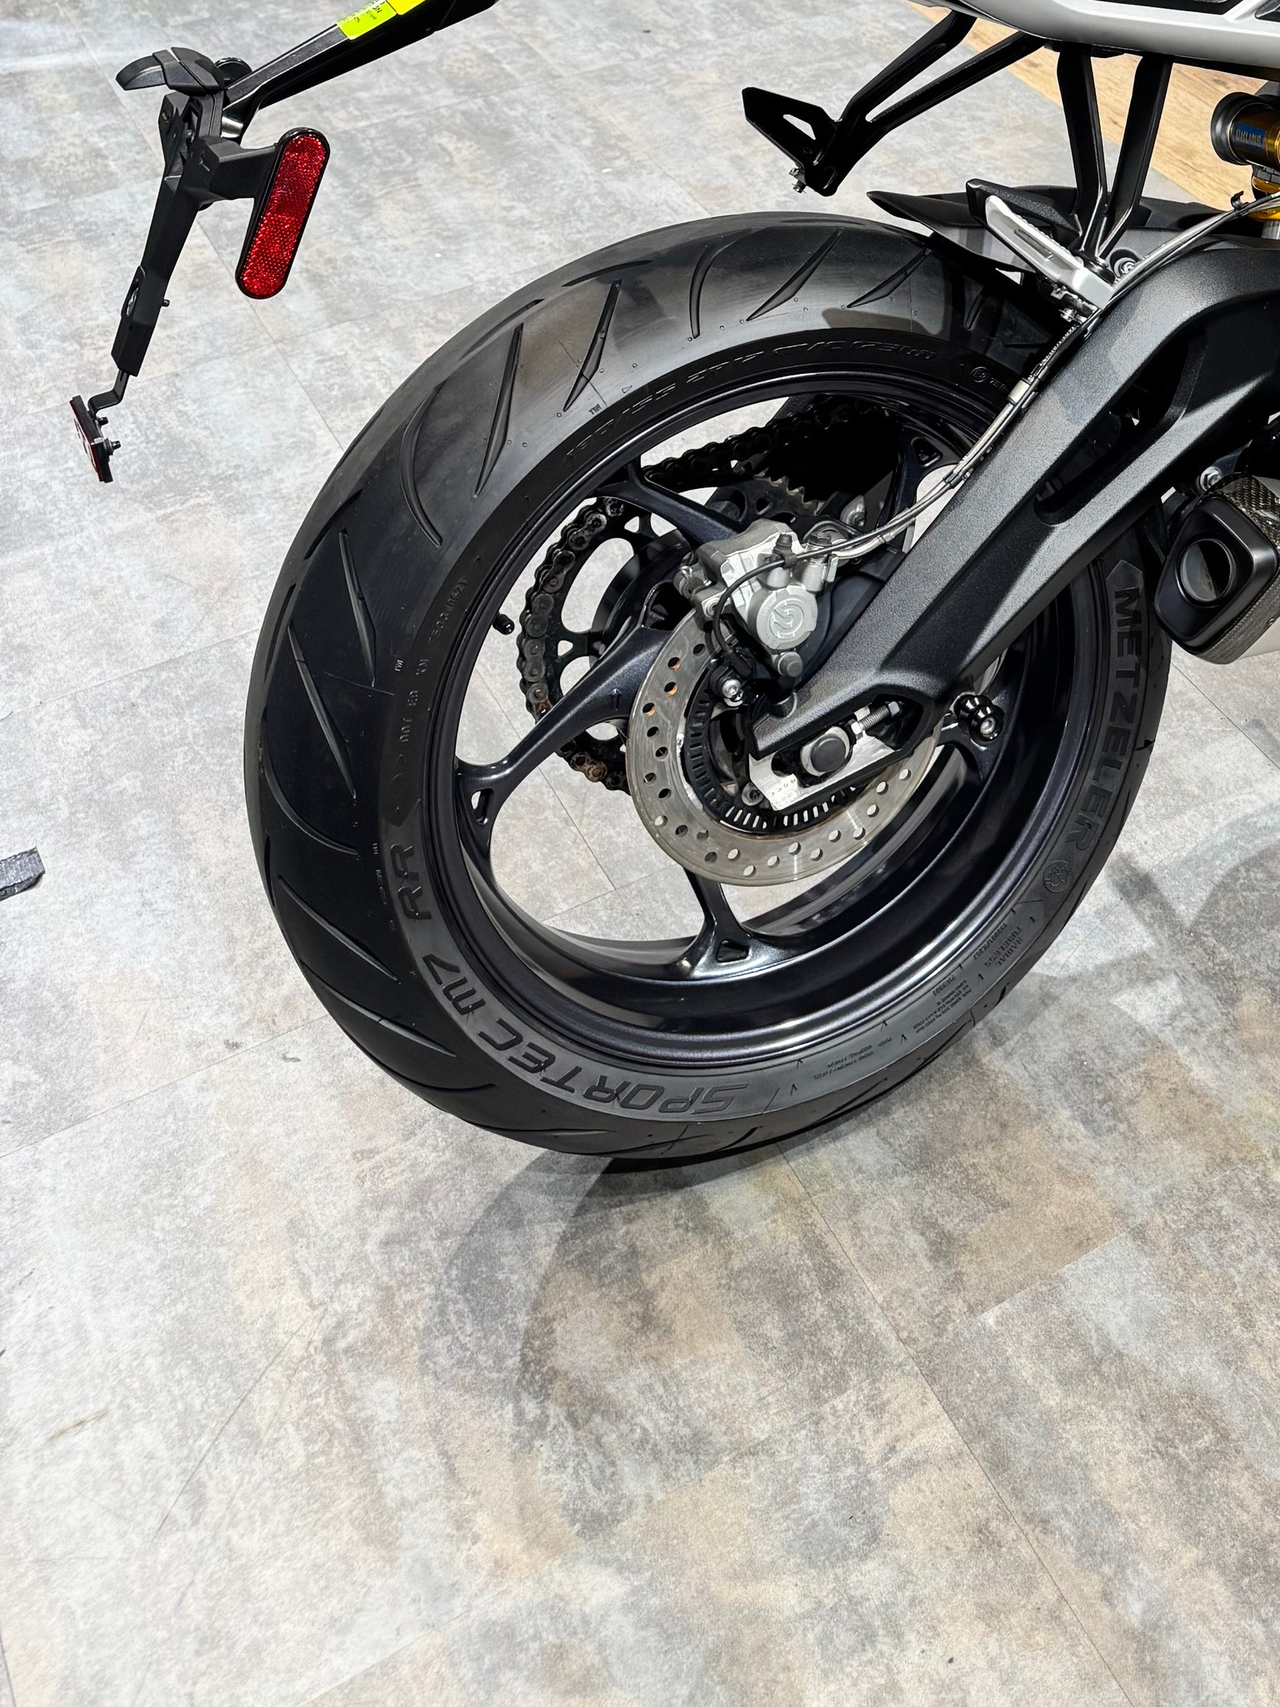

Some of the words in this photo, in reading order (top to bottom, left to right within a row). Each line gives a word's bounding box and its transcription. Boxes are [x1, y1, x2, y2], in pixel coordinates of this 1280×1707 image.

[1065, 586, 1144, 852] METZELER
[390, 840, 432, 921] RR
[422, 952, 486, 1016] M7
[477, 1018, 749, 1115] SPORTEC
